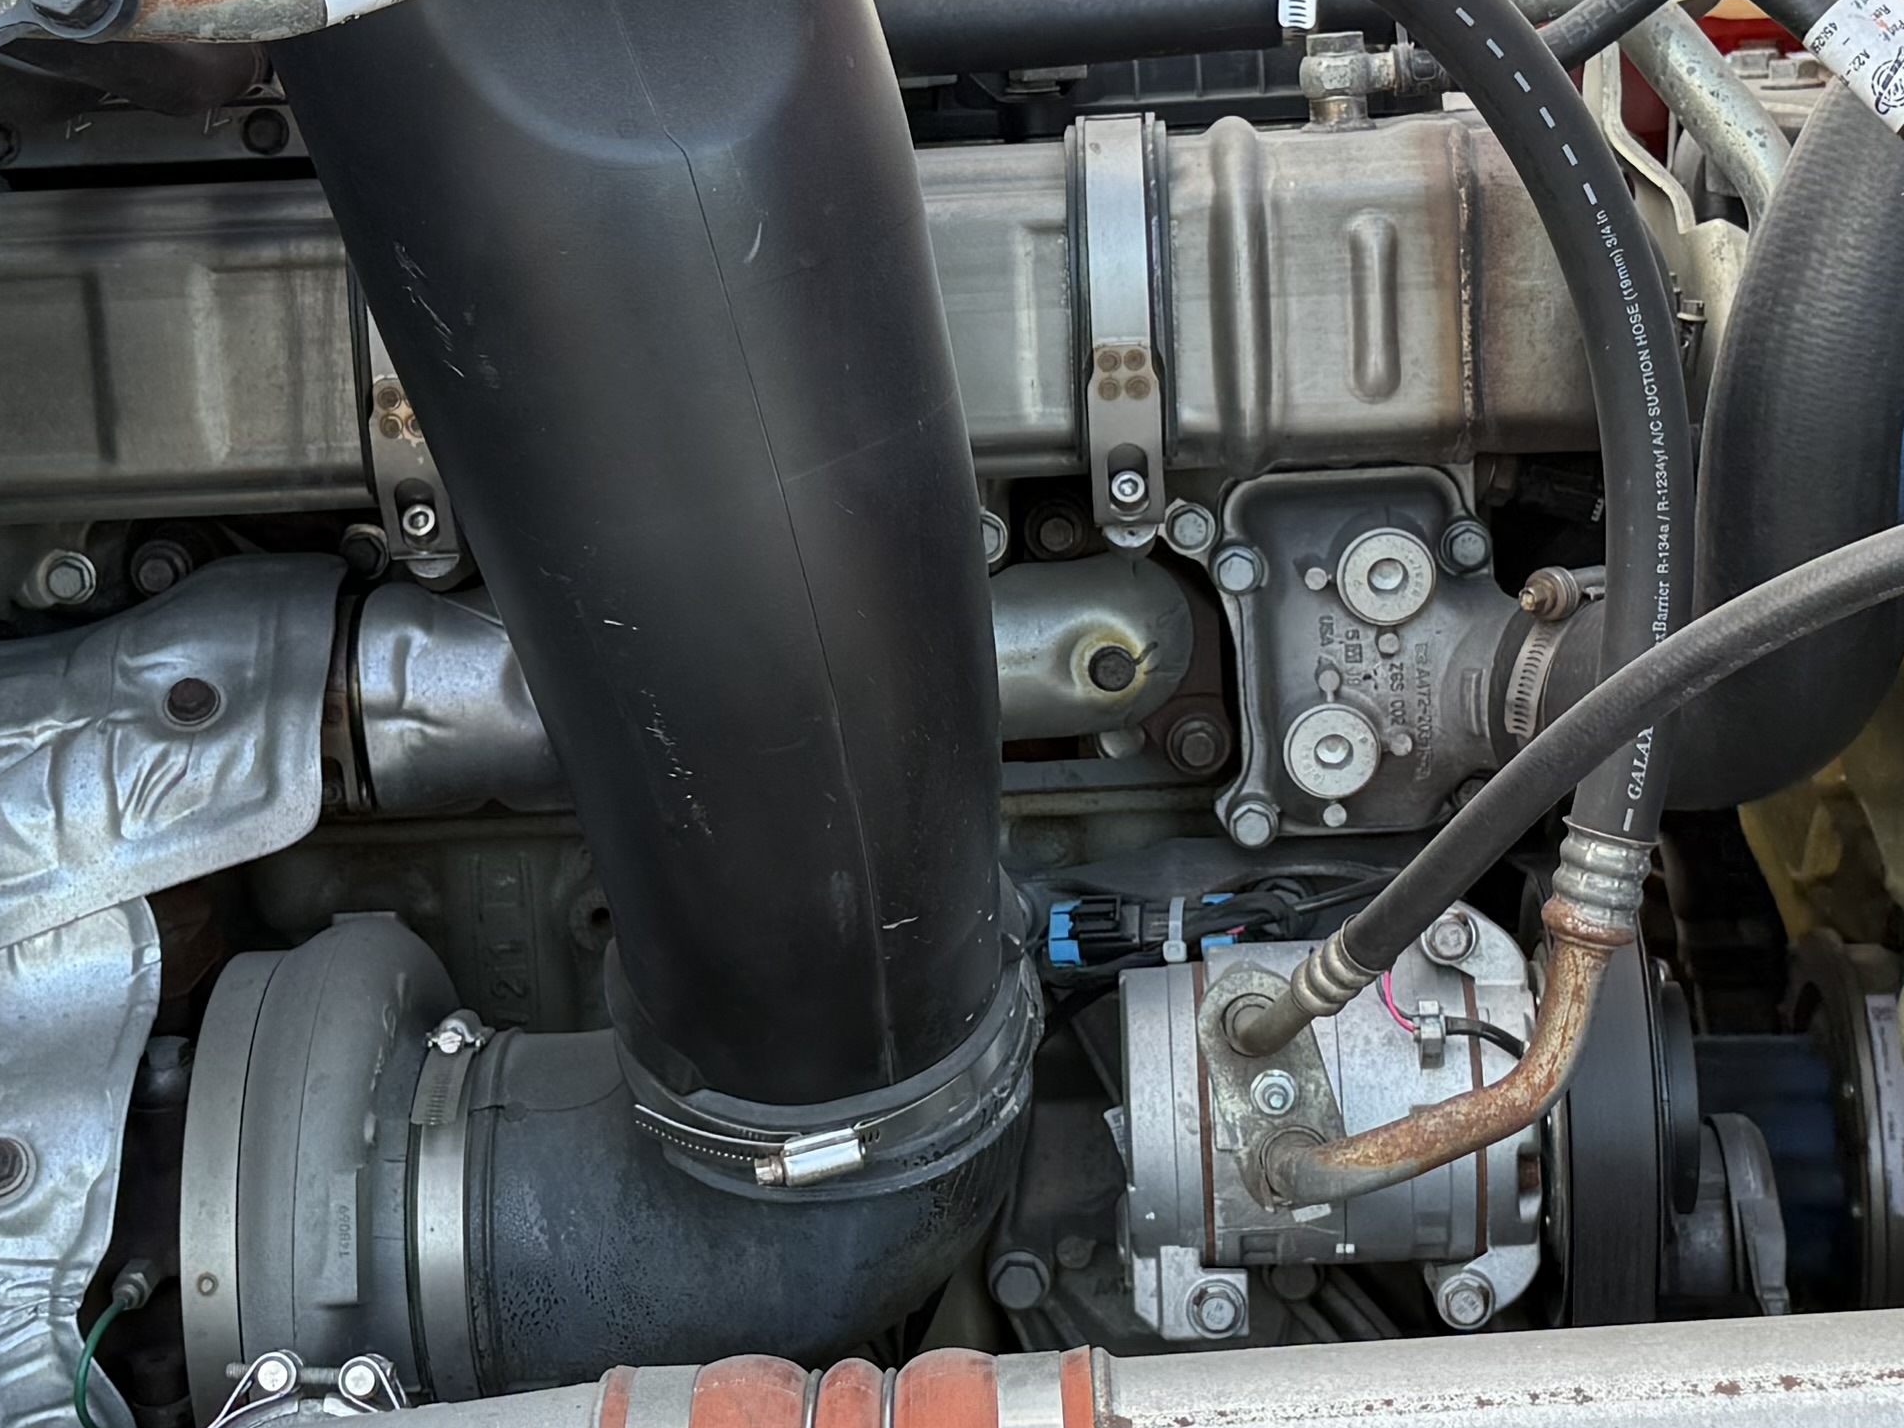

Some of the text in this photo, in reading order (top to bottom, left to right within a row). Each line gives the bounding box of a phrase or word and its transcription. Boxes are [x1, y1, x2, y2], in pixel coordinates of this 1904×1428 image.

[1596, 210, 1606, 224] in
[1600, 224, 1619, 248] 3/4
[1608, 248, 1638, 301] (19mm)
[1627, 302, 1648, 347] HOSE
[1636, 349, 1662, 418] SUCTION
[1649, 419, 1666, 448] A/C
[1655, 449, 1671, 512] R-1234yf
[1656, 523, 1670, 574] R-134a
[1652, 580, 1669, 647] xBarrier
